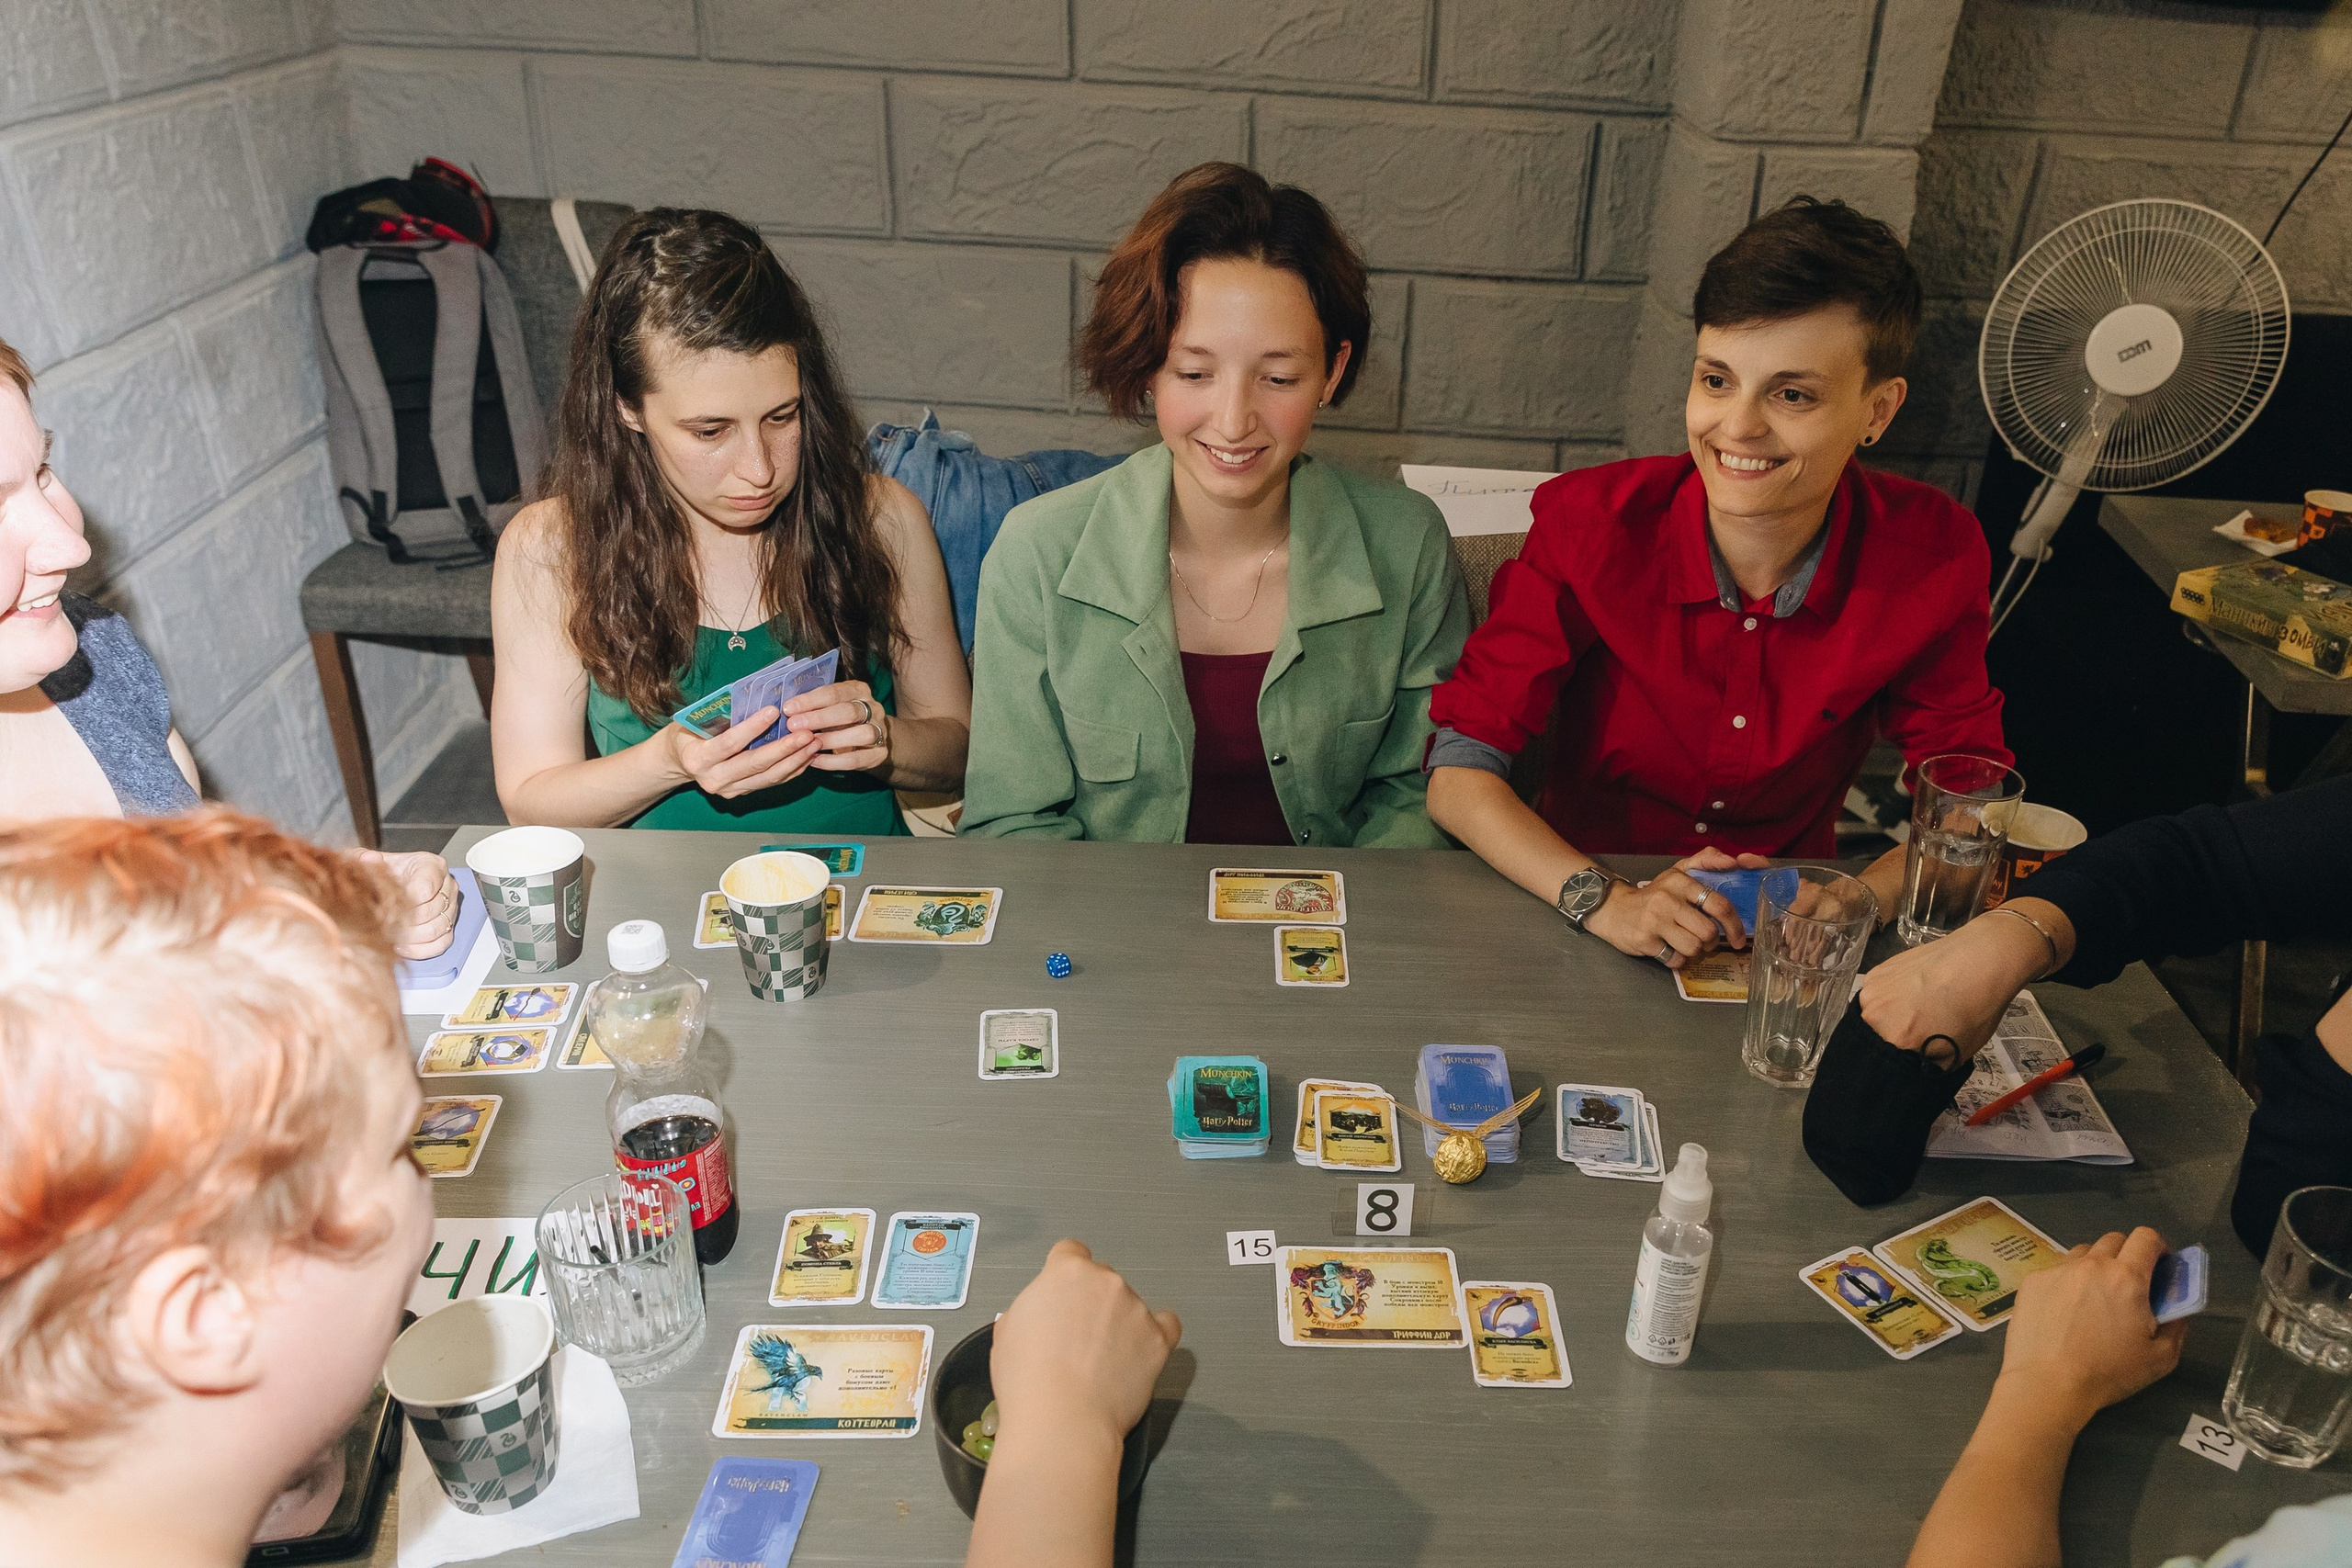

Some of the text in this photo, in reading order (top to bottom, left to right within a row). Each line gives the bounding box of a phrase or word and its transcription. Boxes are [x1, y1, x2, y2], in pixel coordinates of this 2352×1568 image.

[1440, 1055, 1491, 1064] MUNCHKIN
[1200, 1069, 1252, 1078] MUNCHKIN
[1203, 1116, 1253, 1128] Harry Potter
[1364, 1189, 1400, 1232] 8
[1233, 1238, 1273, 1258] 15
[1311, 1318, 1360, 1329] GRYFFINDOR
[2196, 1425, 2234, 1457] 13
